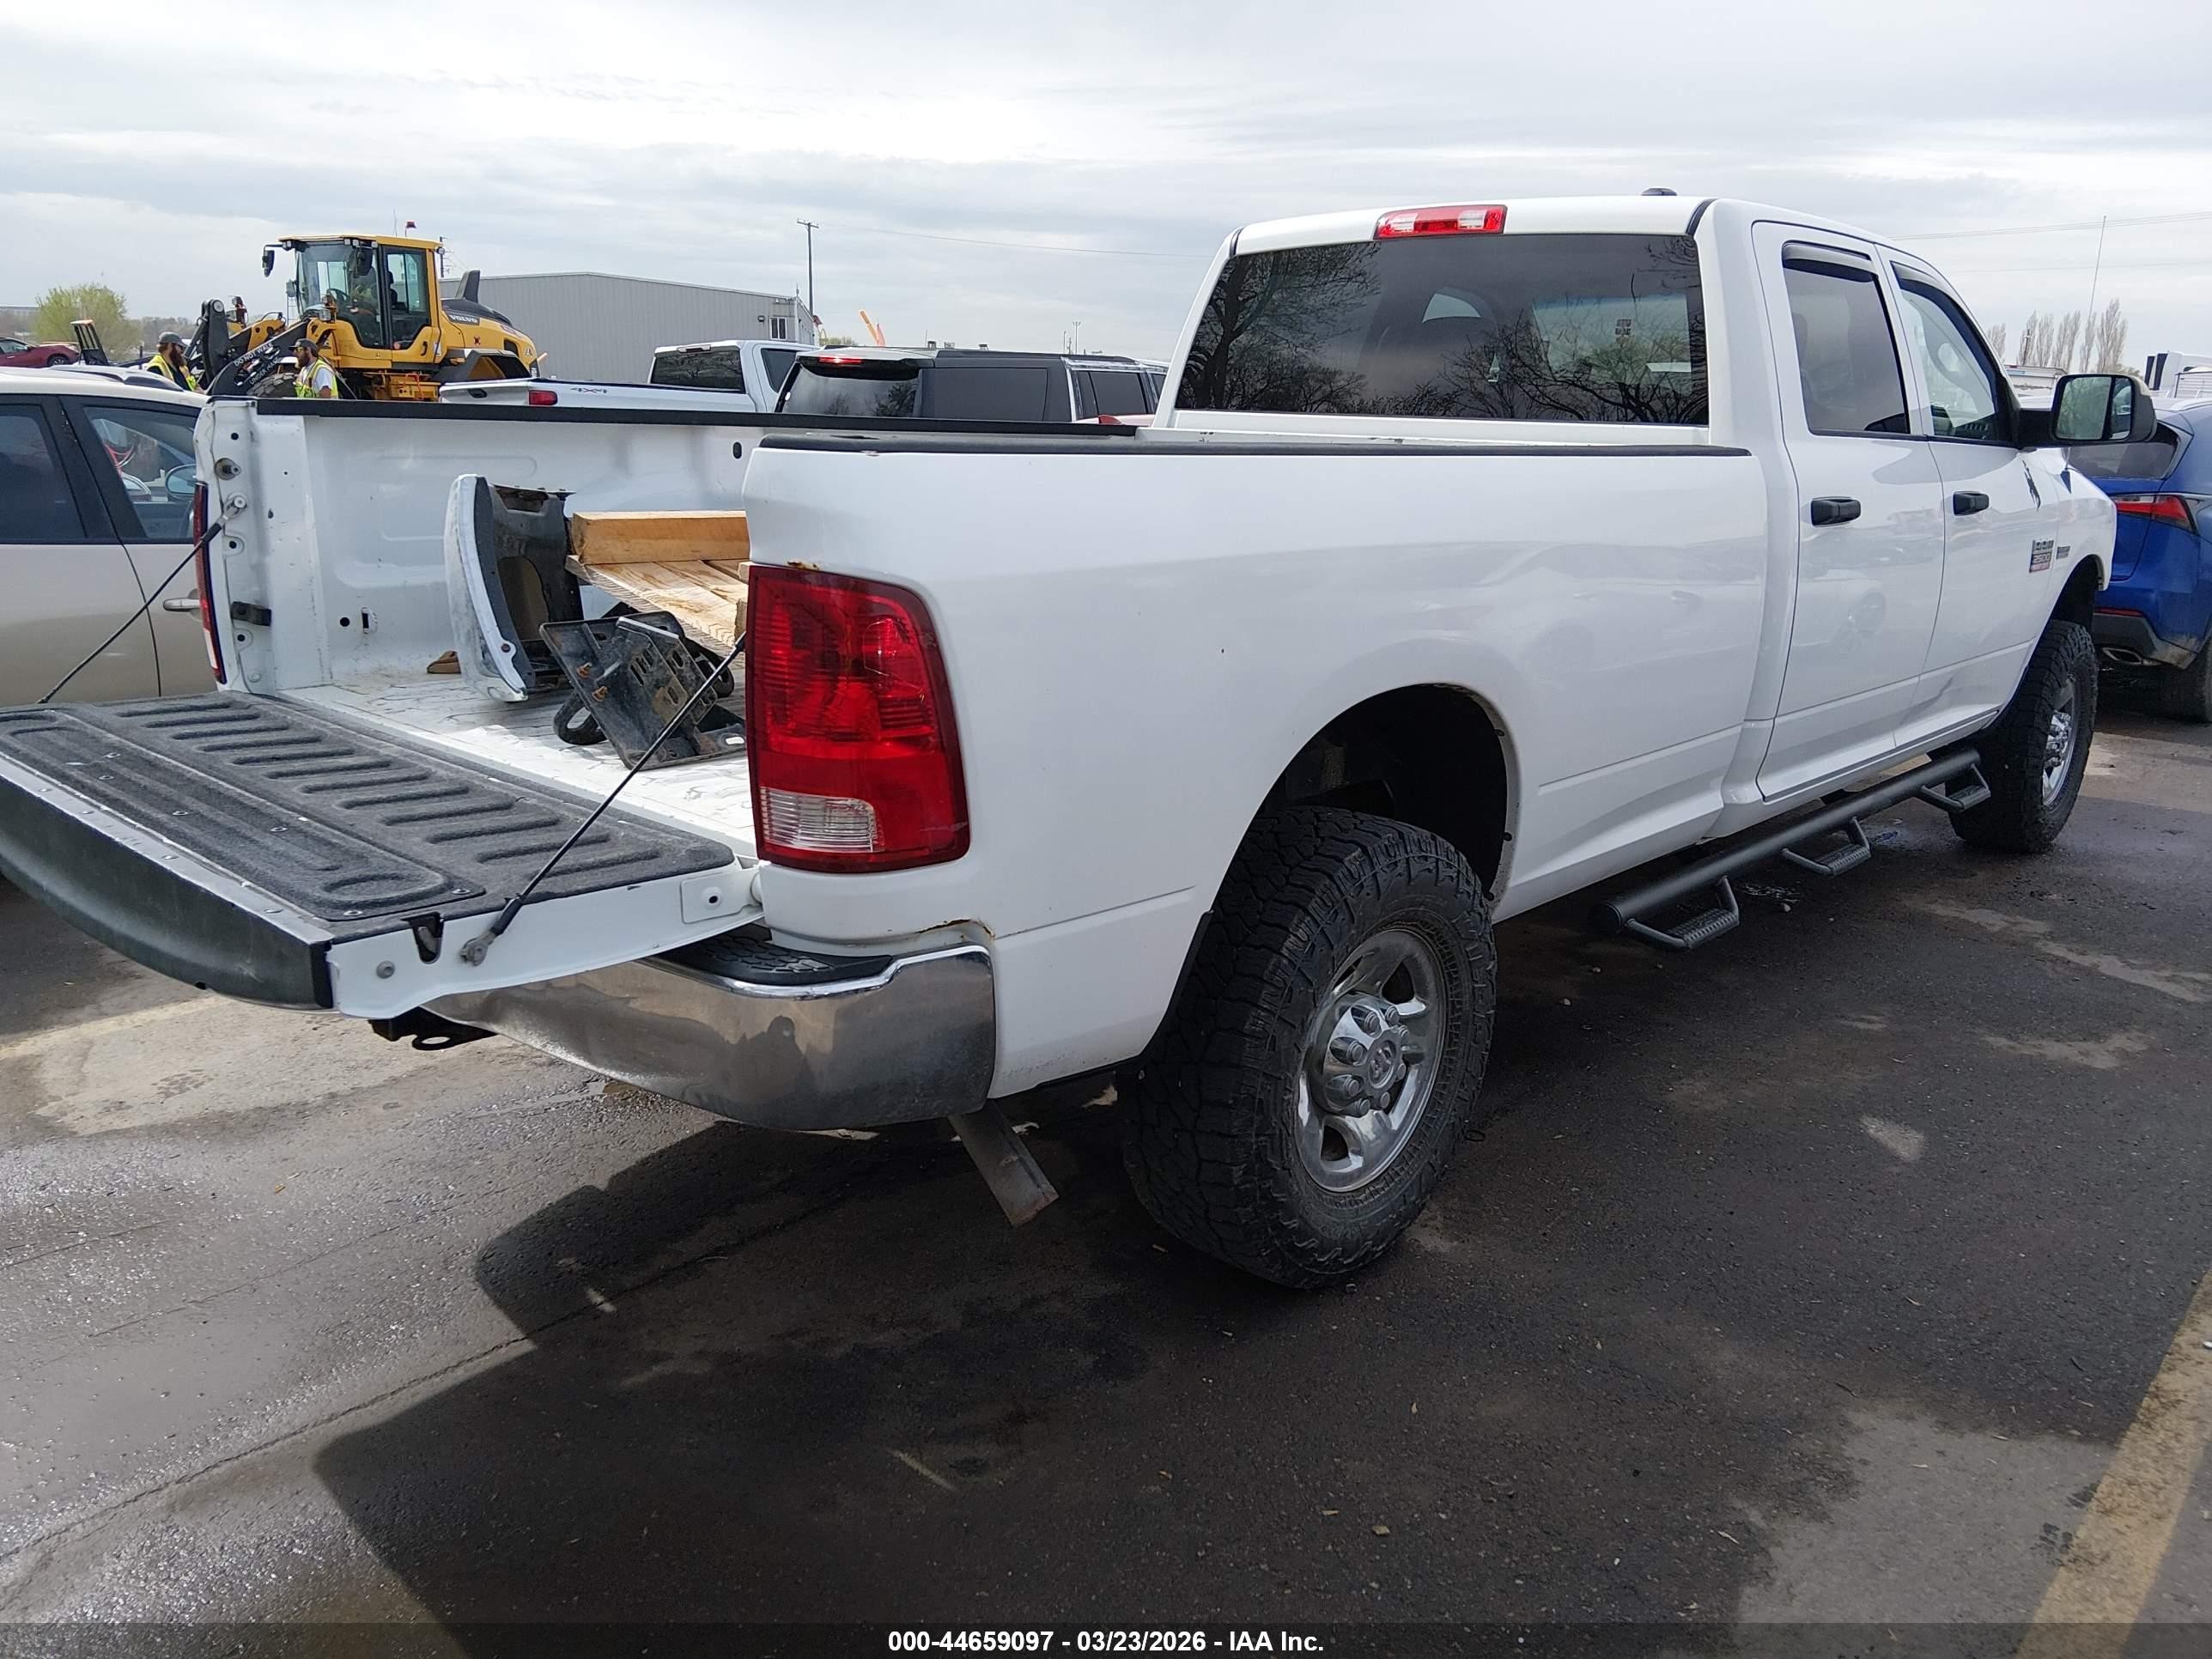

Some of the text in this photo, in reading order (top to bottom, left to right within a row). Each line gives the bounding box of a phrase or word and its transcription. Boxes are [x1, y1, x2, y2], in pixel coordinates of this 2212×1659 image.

[448, 314, 478, 324] VOLVO
[234, 342, 273, 367] DO NOT WALK
[249, 368, 267, 385] UNDER
